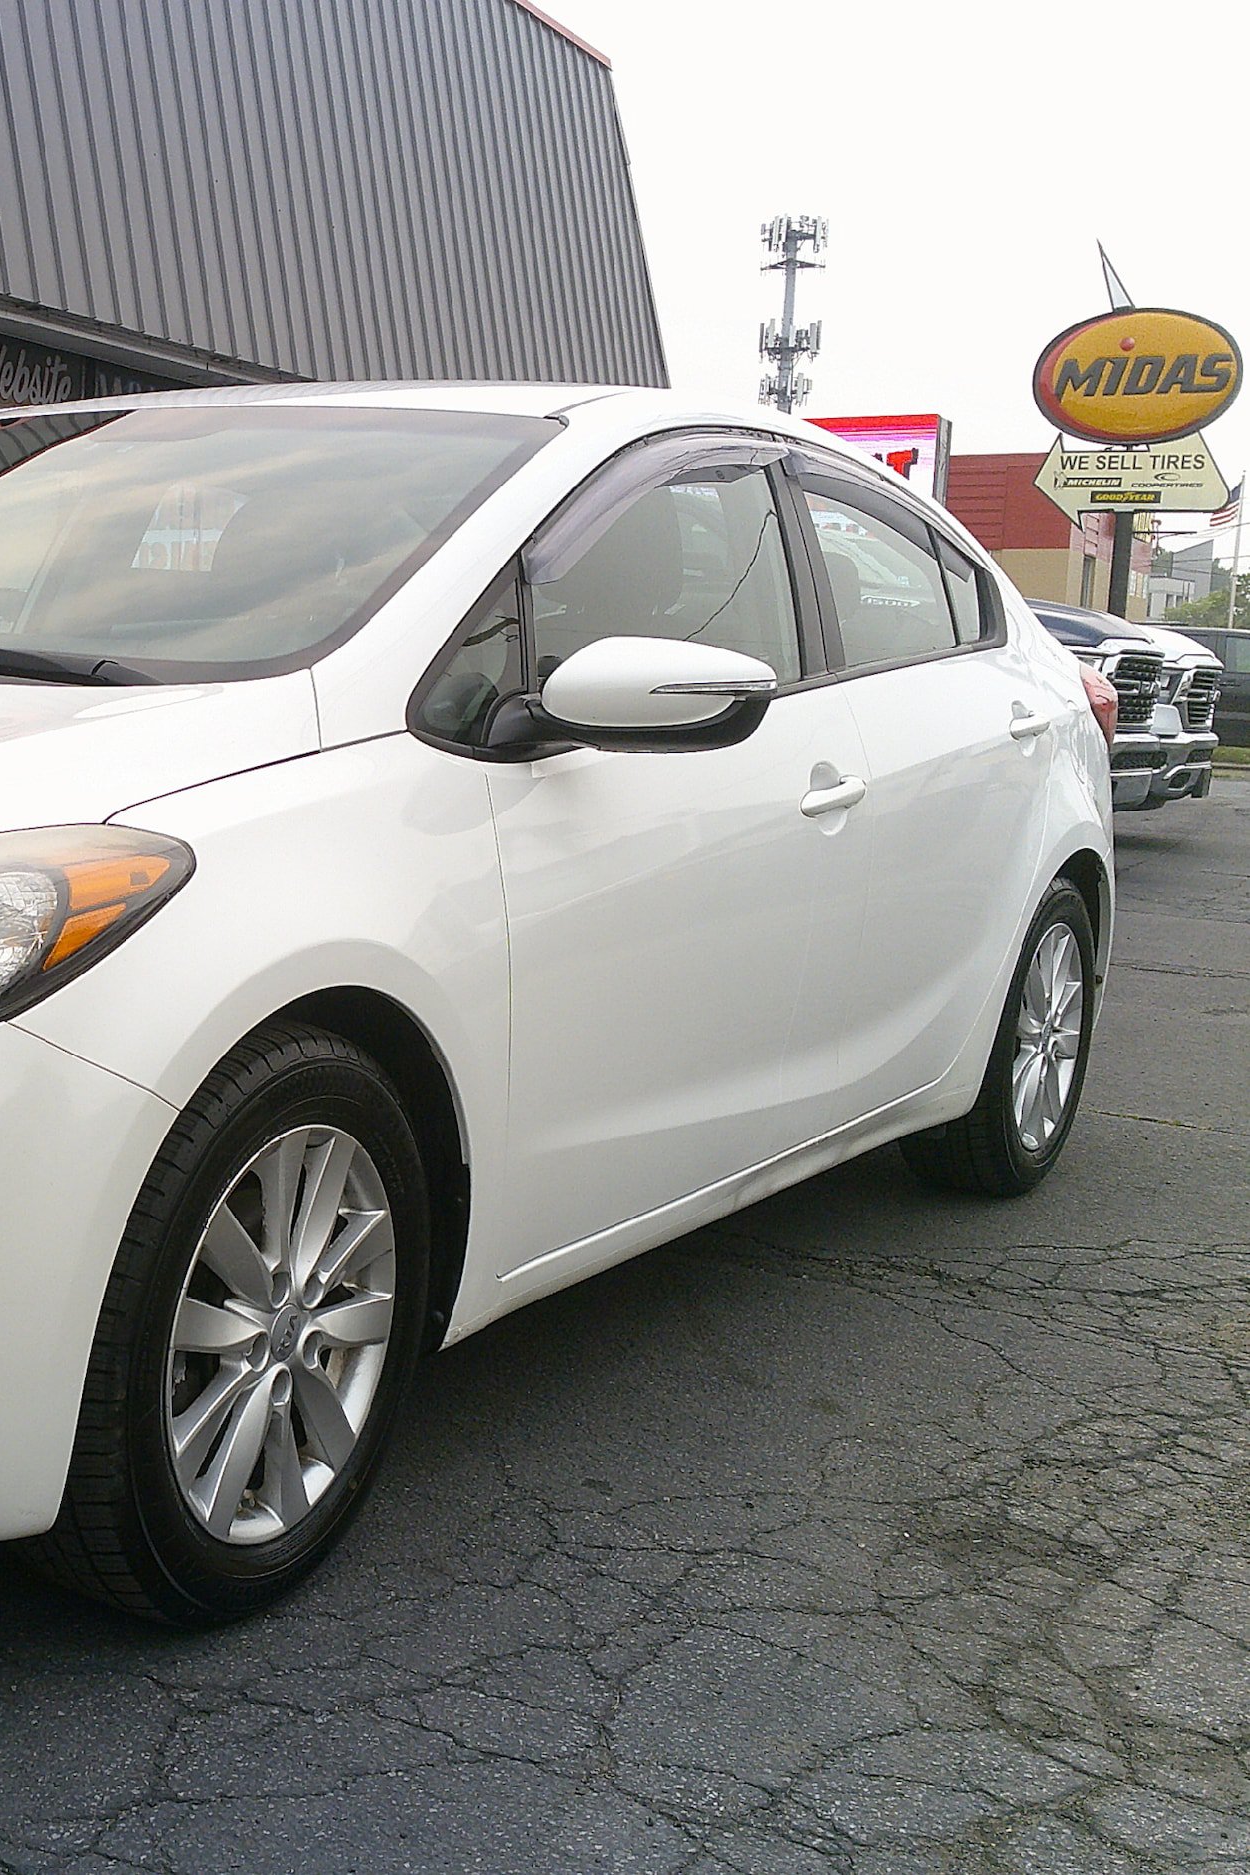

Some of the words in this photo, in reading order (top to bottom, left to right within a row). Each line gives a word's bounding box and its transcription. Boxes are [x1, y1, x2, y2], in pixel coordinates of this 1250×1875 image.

[1056, 352, 1234, 402] MIDAS
[1060, 455, 1090, 470] WE
[1095, 455, 1142, 470] SELL
[1149, 454, 1205, 470] TIRES
[1067, 478, 1121, 487] MICHELIN
[1095, 491, 1156, 502] GOODYEAR
[276, 1315, 298, 1353] KIA
